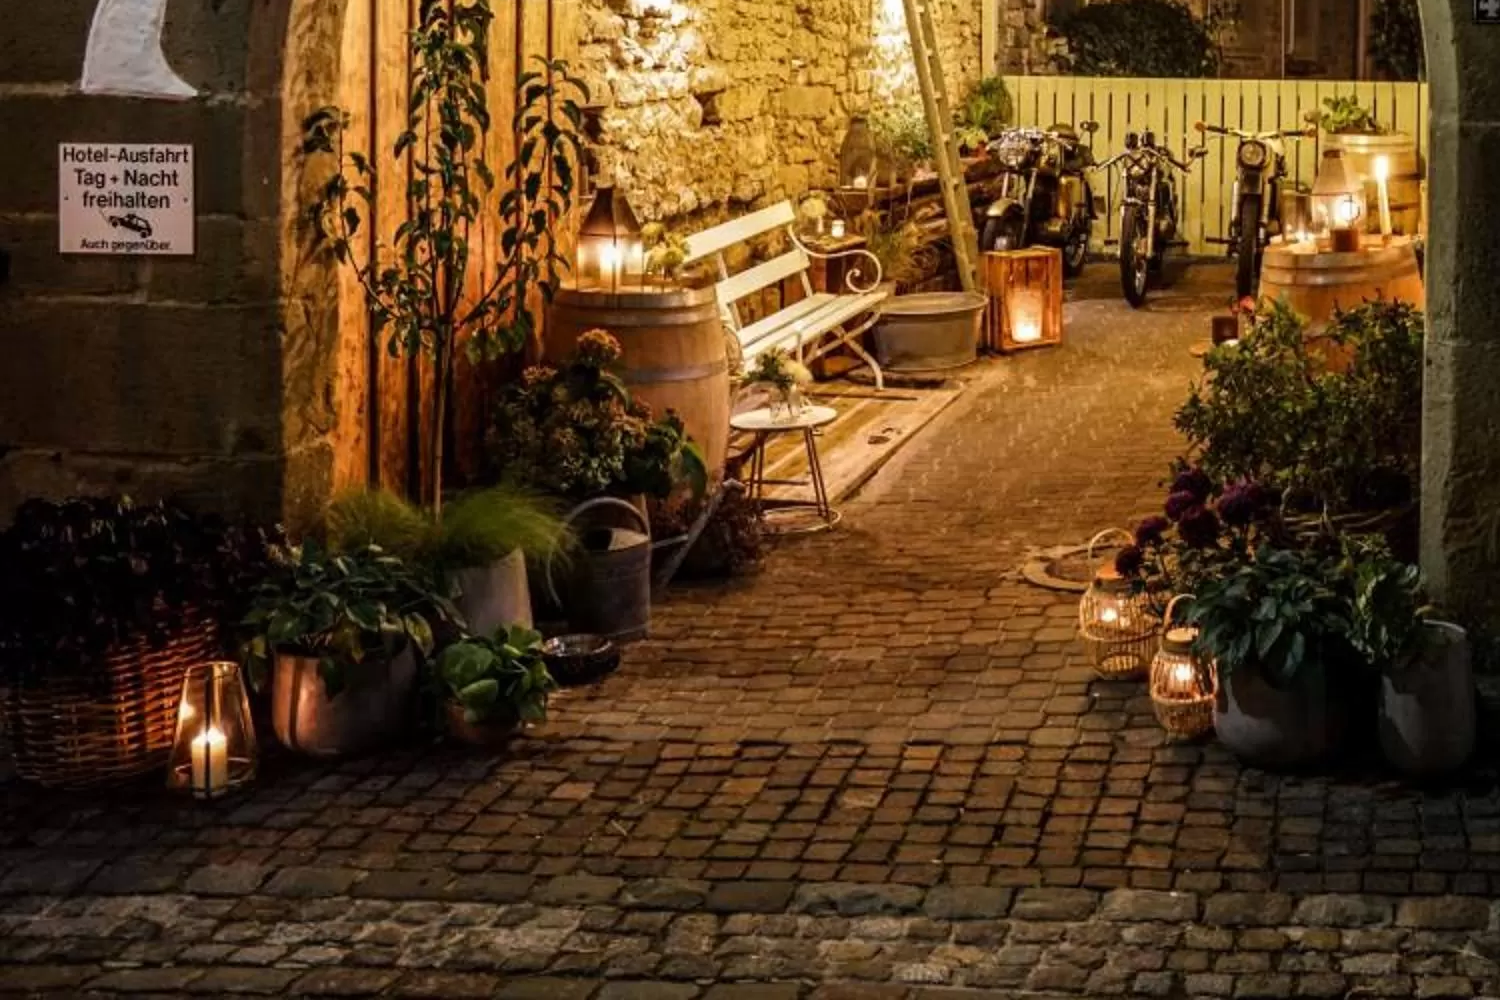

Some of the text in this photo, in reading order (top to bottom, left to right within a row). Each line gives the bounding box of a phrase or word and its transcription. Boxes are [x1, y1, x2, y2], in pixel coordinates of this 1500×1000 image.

[62, 147, 189, 163] Hotel-Ausfahrt
[74, 168, 106, 189] Tag
[123, 169, 179, 187] Nacht
[82, 191, 171, 209] freihalten
